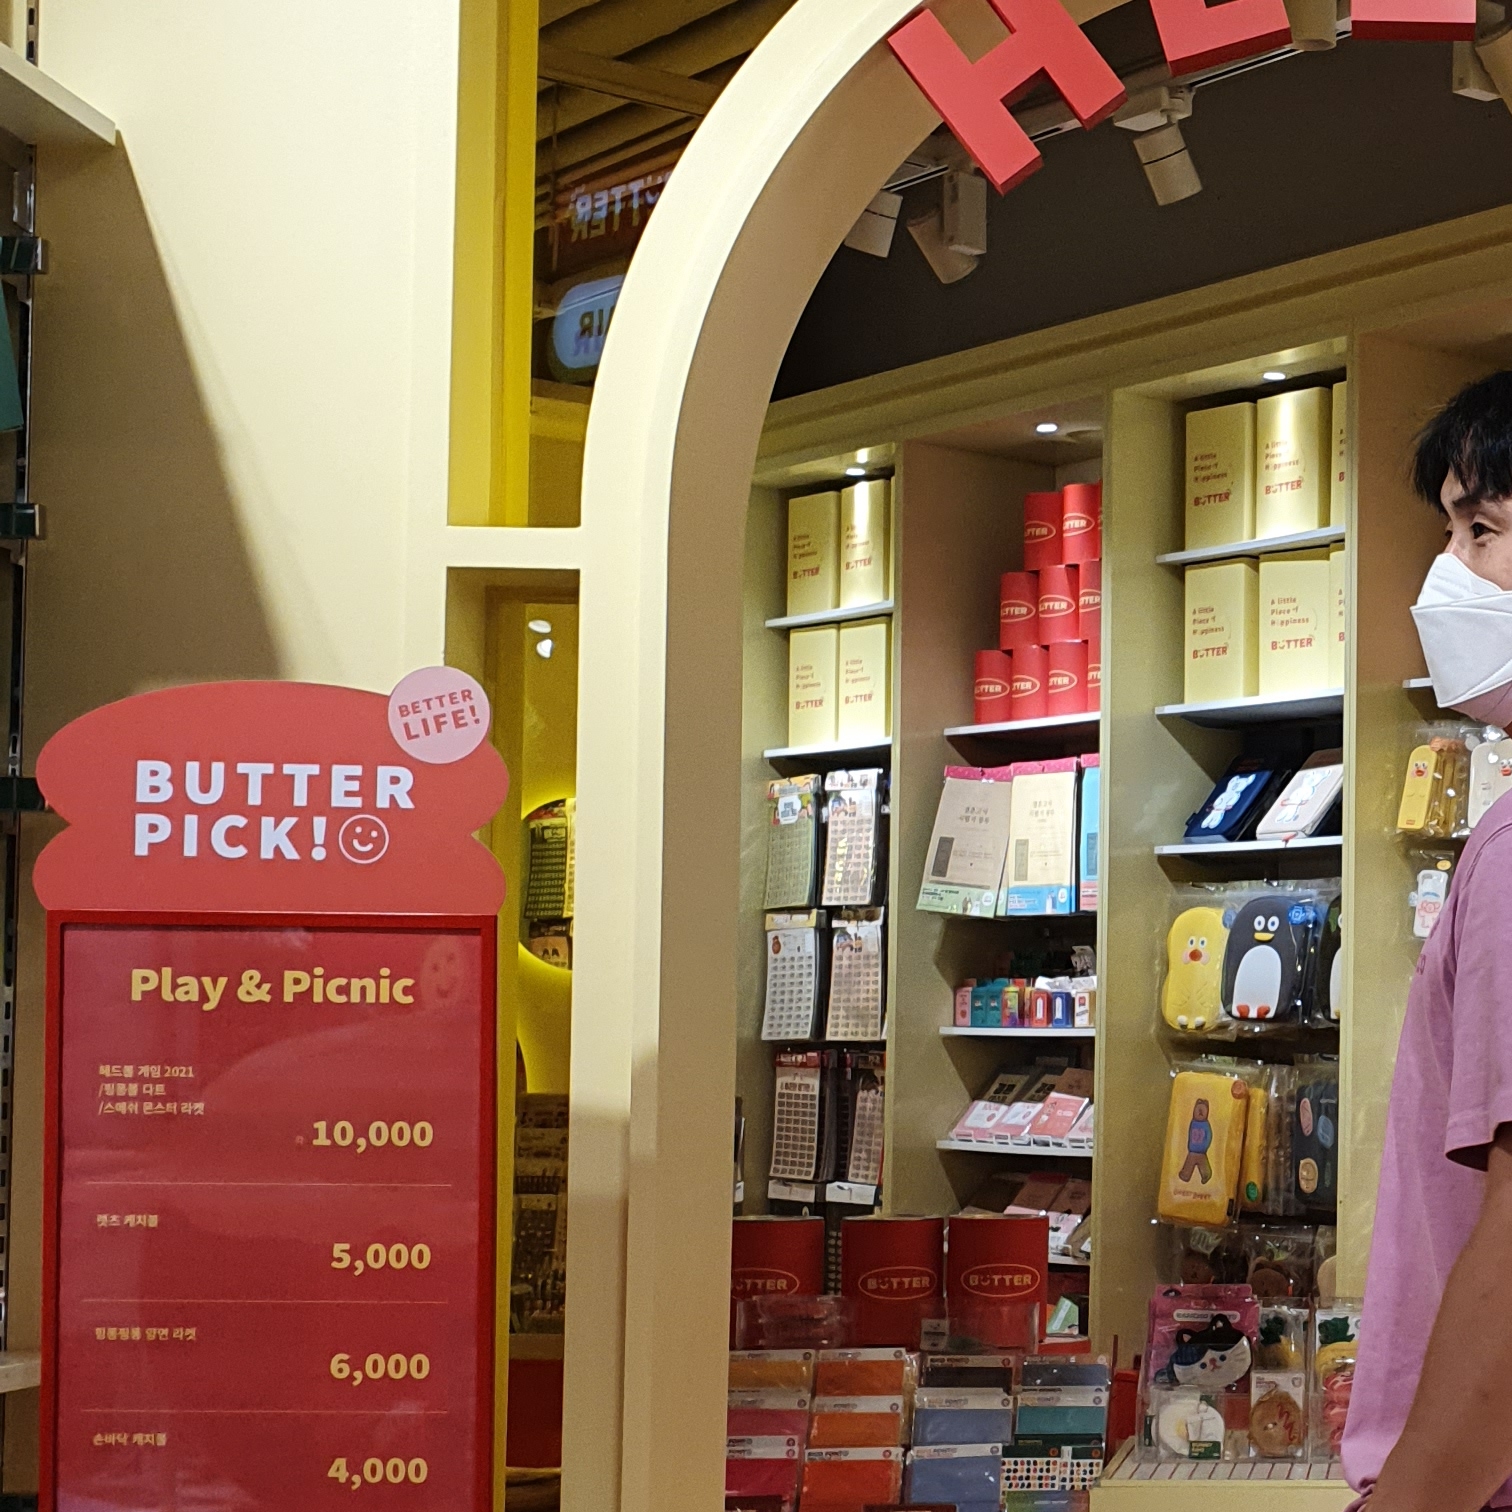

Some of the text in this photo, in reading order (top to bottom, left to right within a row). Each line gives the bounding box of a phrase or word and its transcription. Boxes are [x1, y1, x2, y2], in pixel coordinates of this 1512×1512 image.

[398, 688, 475, 718] BETTER
[403, 705, 482, 741] LIFE!
[135, 759, 415, 809] BUTTER
[134, 813, 328, 861] PICK!
[131, 966, 416, 1011] Play & Picnic
[164, 1066, 195, 1078] 2021
[312, 1120, 434, 1153] 10,000
[330, 1243, 431, 1276] 5,000
[734, 1277, 788, 1291] UTTER
[329, 1353, 430, 1386] 6,000
[327, 1457, 428, 1490] 4,000
